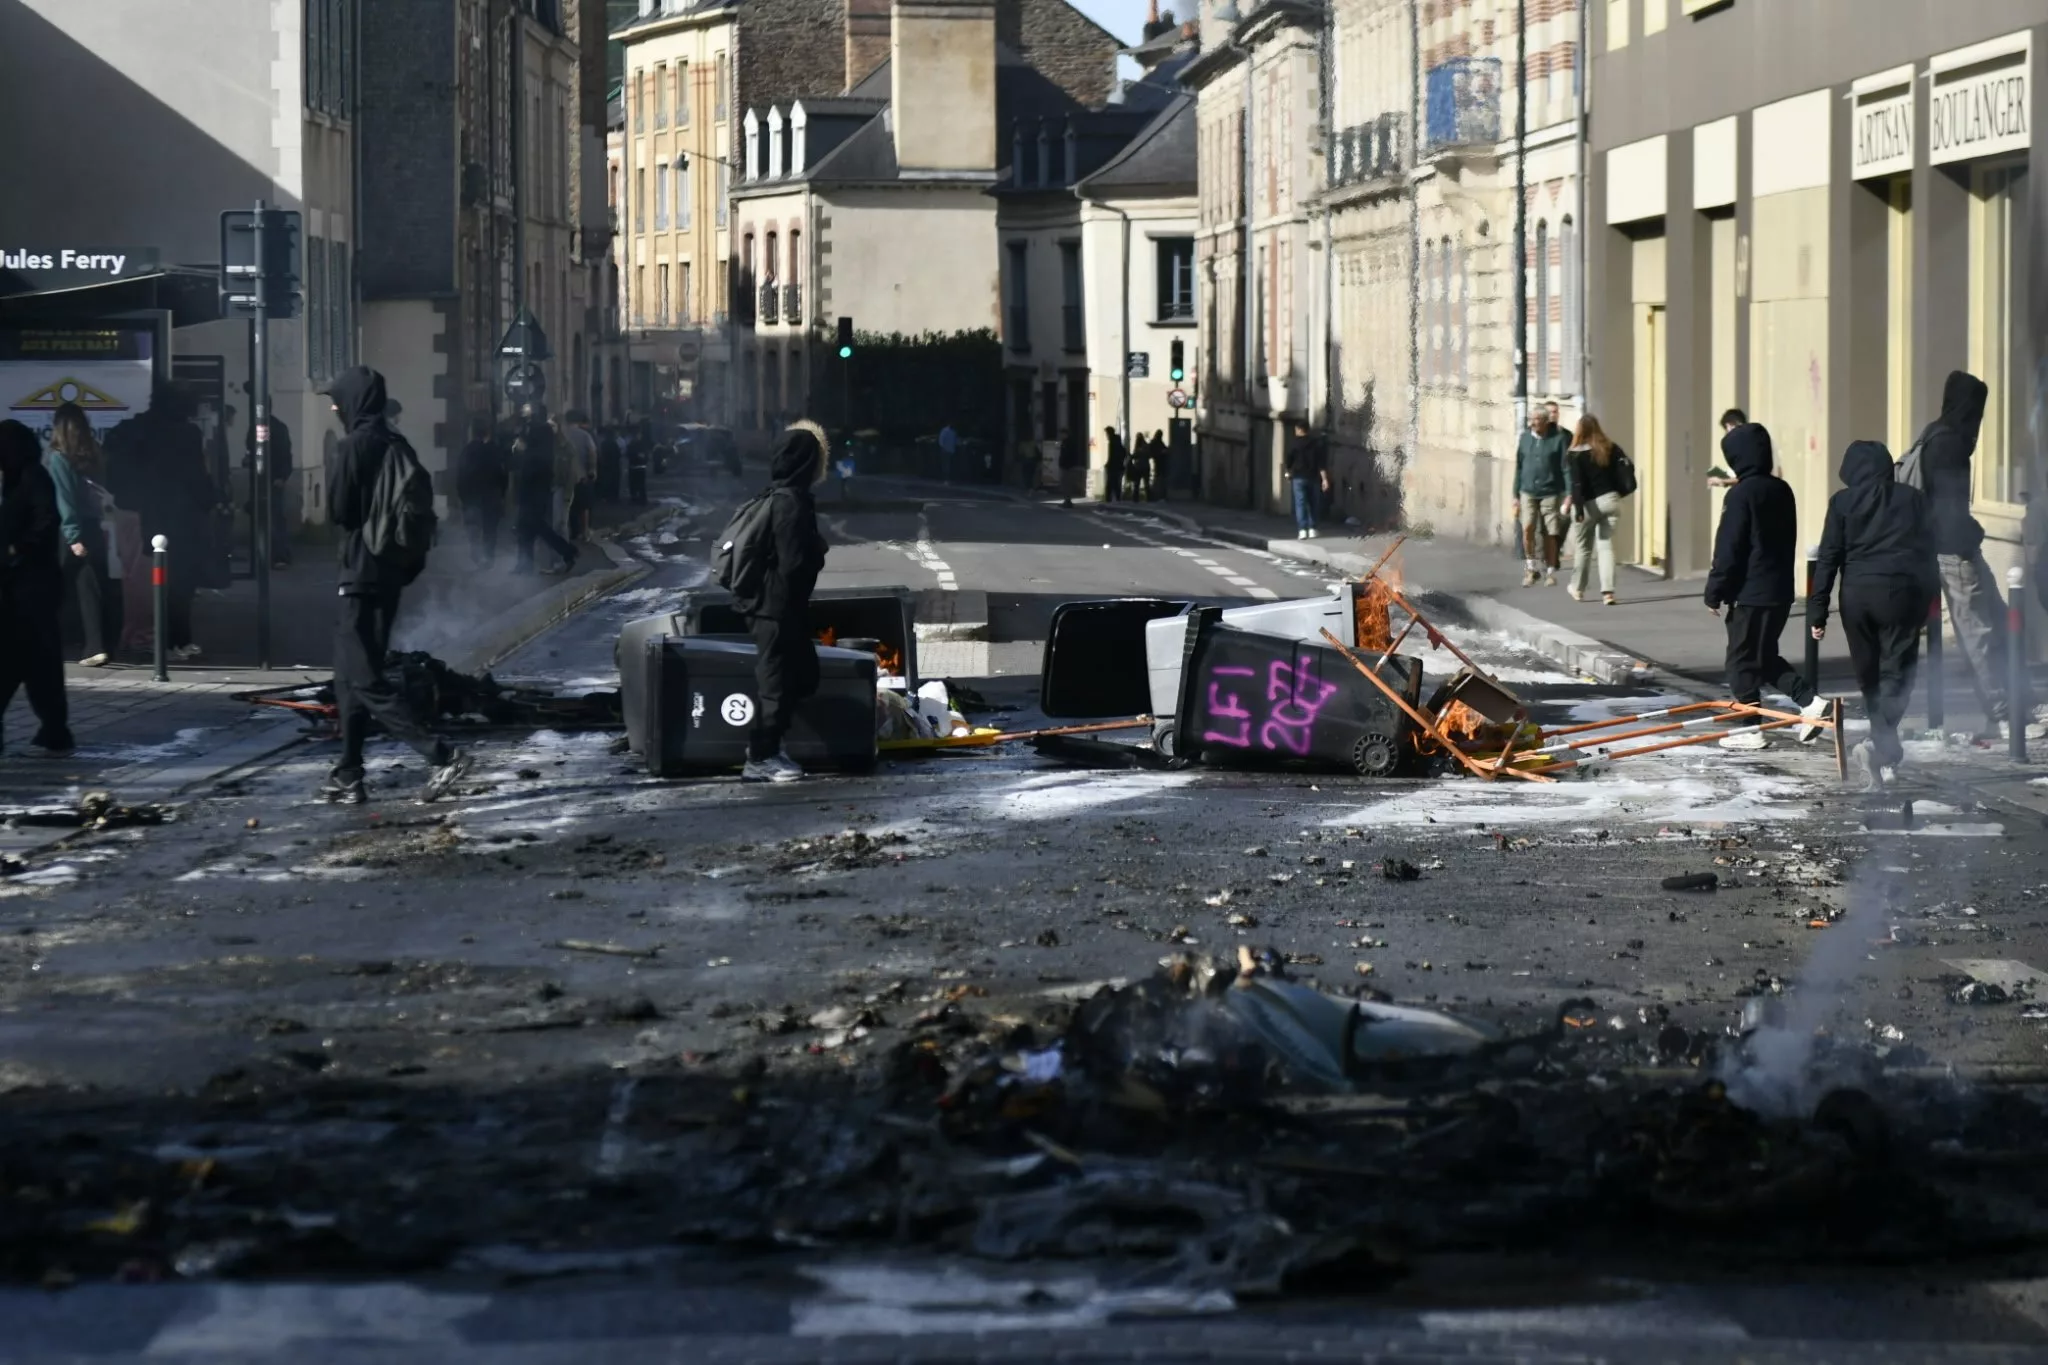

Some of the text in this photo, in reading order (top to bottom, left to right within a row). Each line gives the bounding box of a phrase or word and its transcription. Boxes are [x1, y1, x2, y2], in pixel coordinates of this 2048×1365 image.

[1856, 76, 2027, 166] ARTISAN BOULANGER
[61, 249, 126, 275] Ferry
[728, 699, 747, 722] C2
[1204, 665, 1255, 747] LFI
